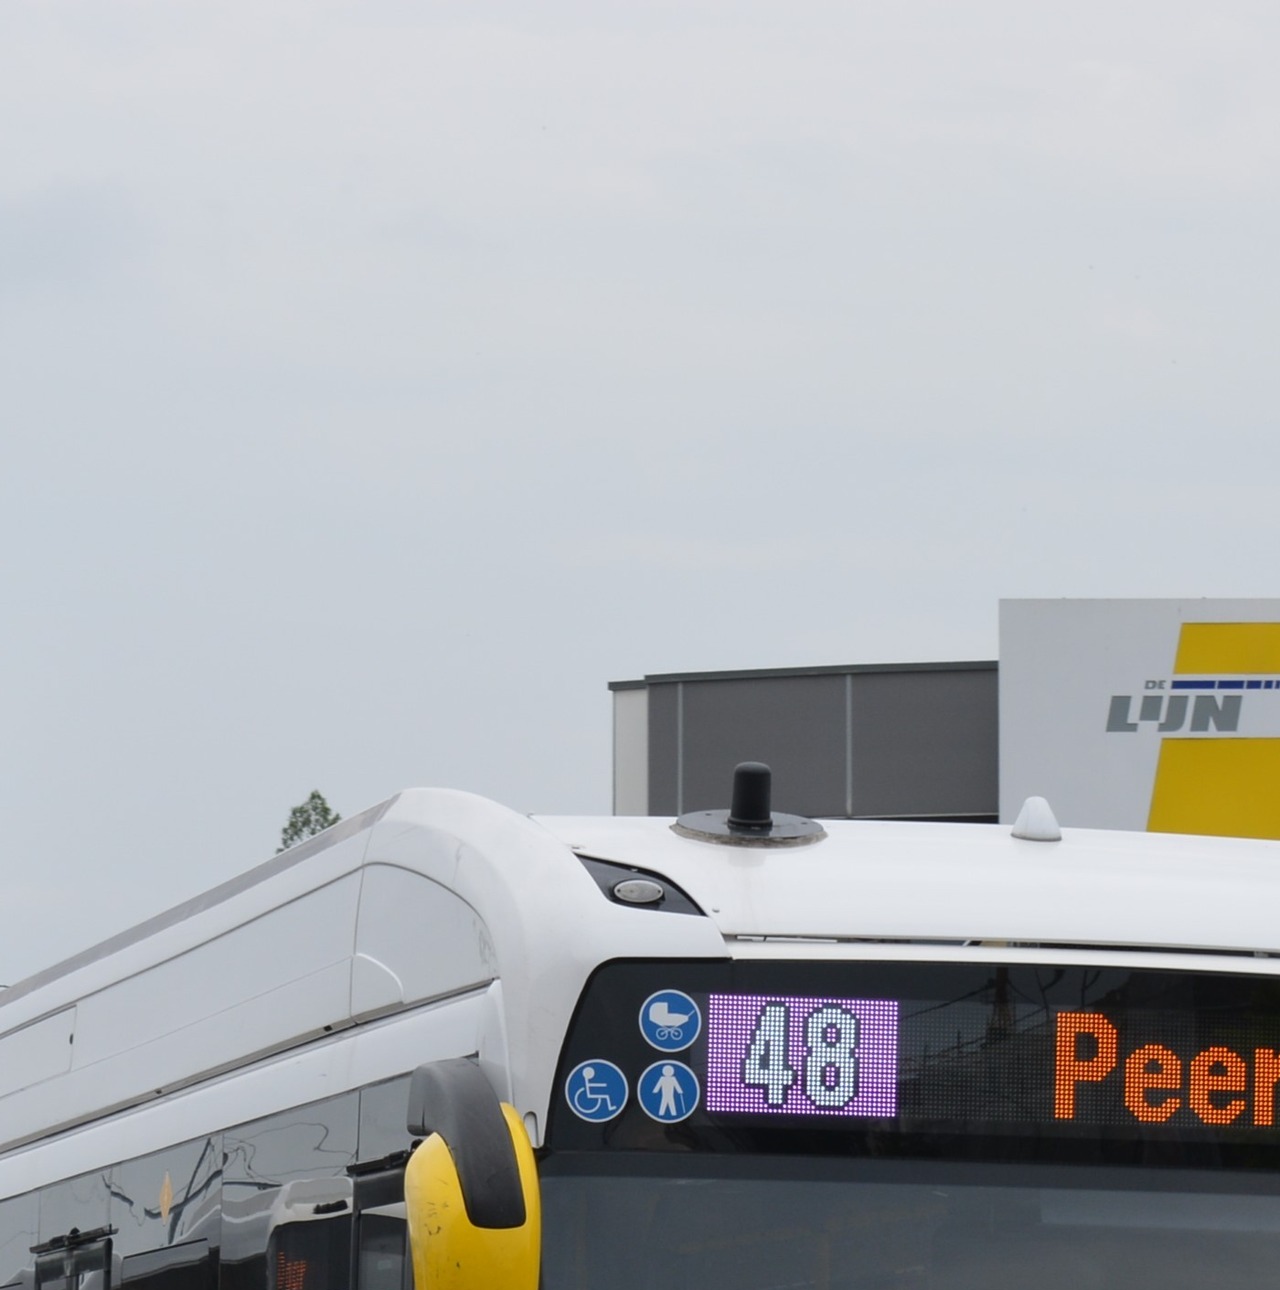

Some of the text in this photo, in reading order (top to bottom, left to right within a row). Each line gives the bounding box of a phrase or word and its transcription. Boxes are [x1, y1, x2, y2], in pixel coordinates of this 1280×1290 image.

[1144, 680, 1166, 690] DE
[1105, 695, 1243, 732] LIJN
[743, 1003, 858, 1108] 48
